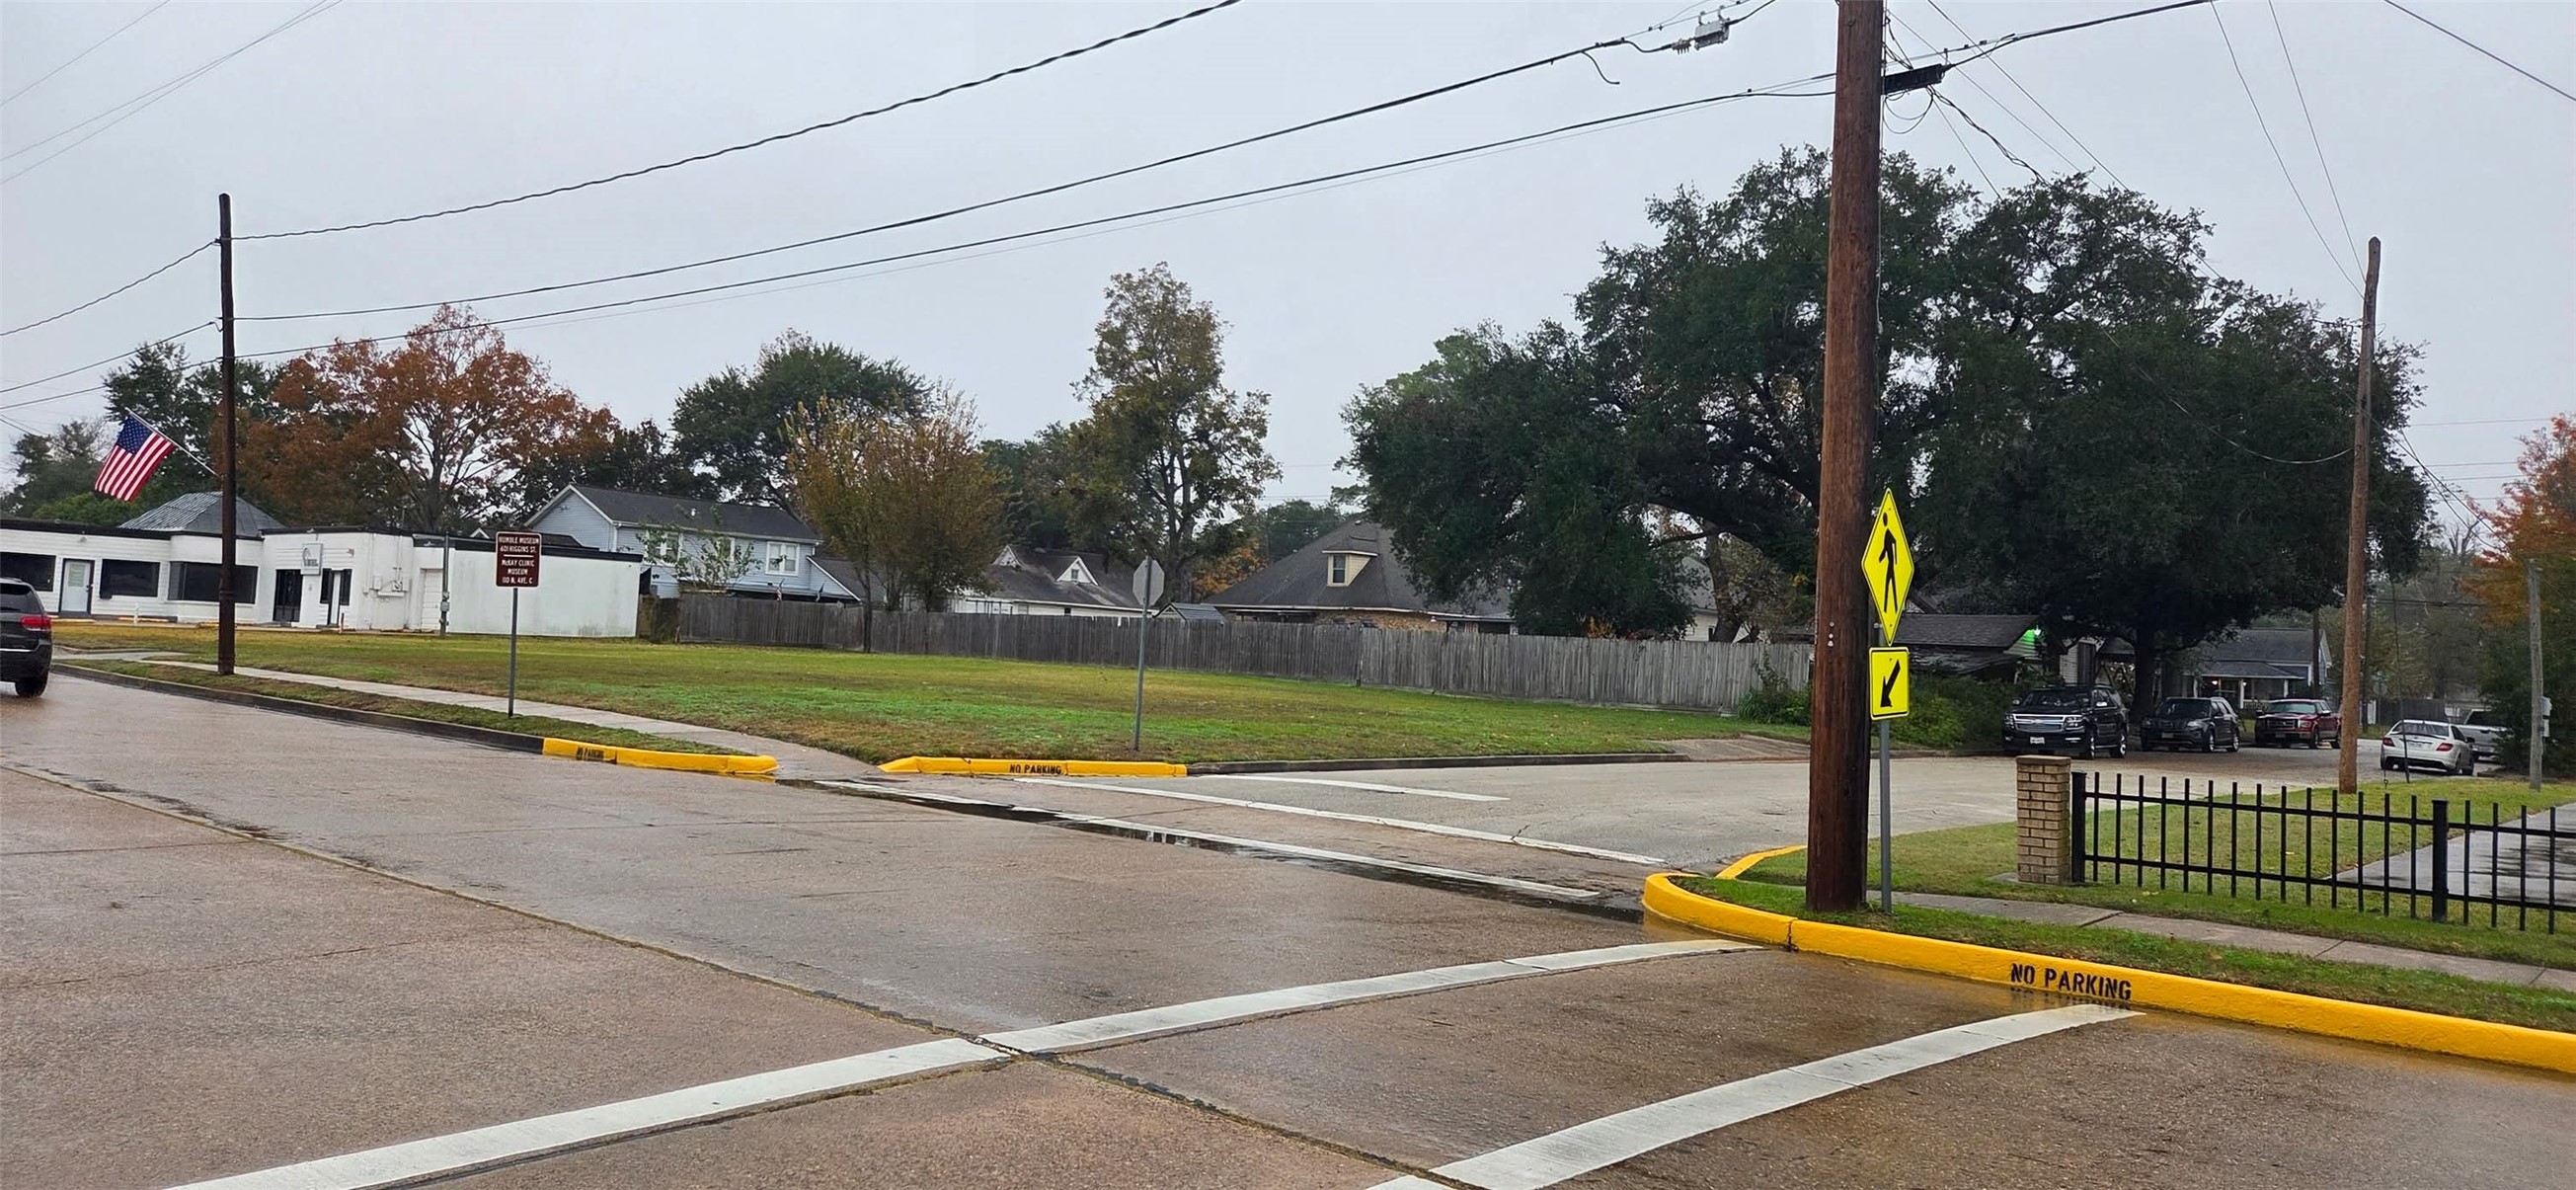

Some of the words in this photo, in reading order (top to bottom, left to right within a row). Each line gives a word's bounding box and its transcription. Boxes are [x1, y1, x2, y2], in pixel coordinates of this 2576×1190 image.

[1009, 763, 1021, 773] NO
[1024, 764, 1062, 774] PARKING
[2010, 963, 2035, 985] NO
[2045, 968, 2132, 1000] PARKING
